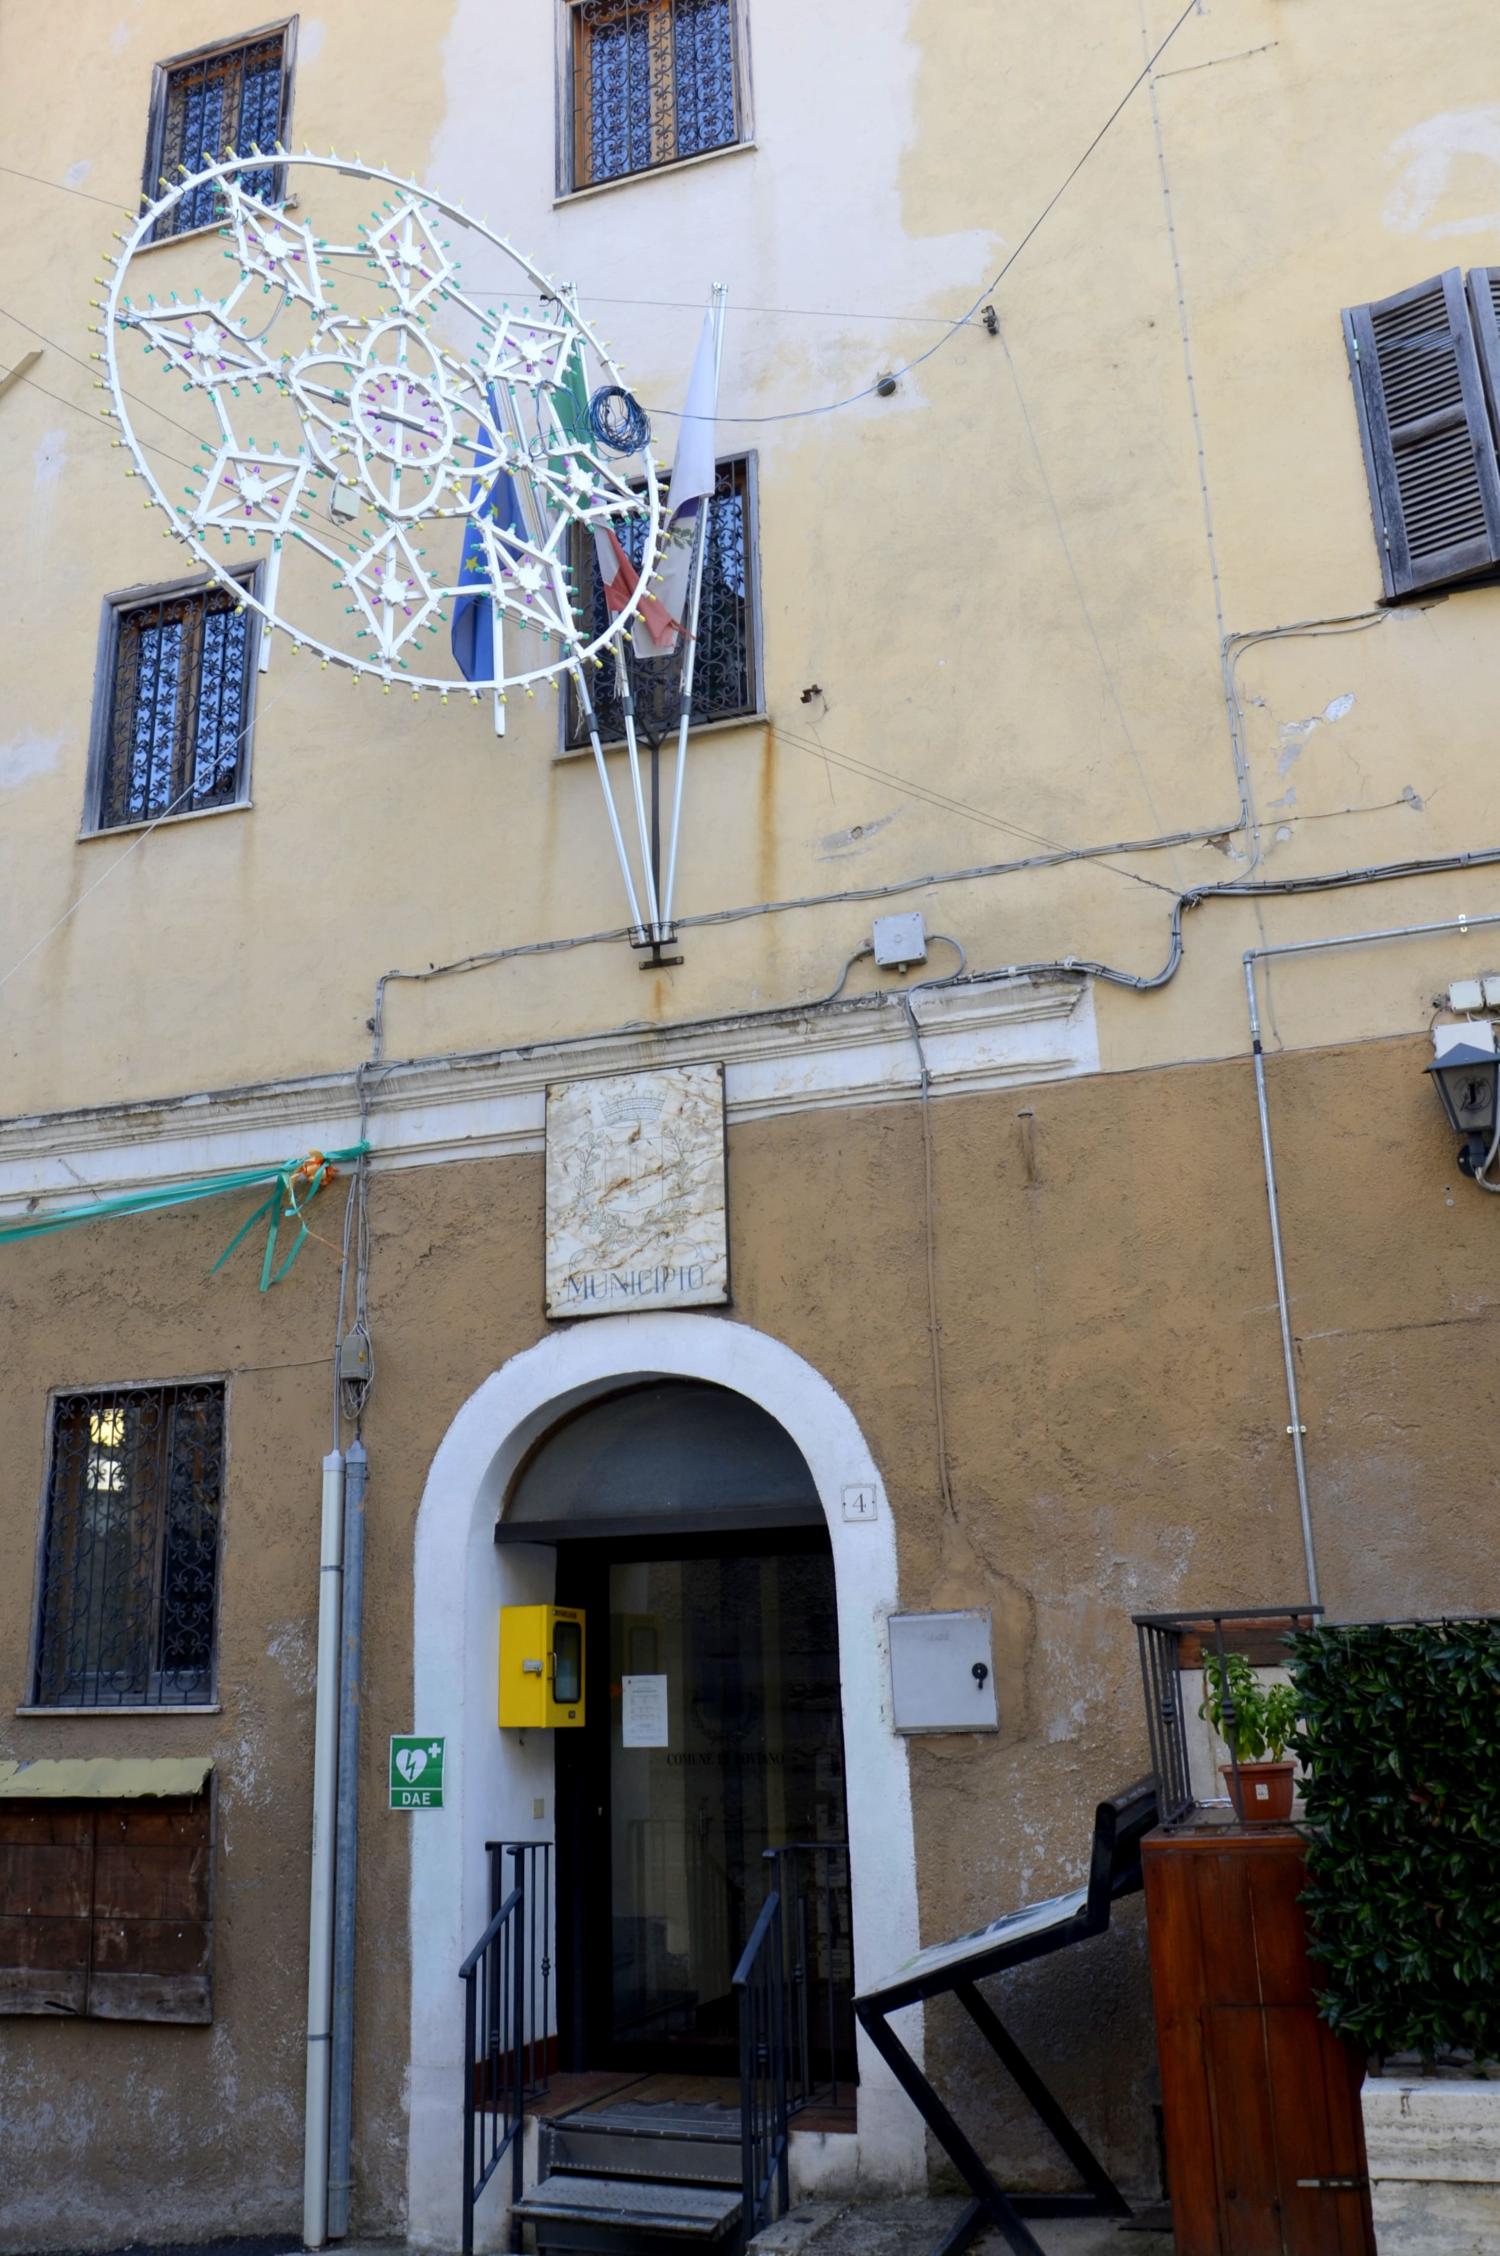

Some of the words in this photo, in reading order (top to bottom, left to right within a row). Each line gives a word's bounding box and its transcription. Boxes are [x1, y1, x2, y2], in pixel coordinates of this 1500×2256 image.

[567, 1264, 704, 1301] MUNICIPIO
[852, 1493, 866, 1512] 4
[666, 1752, 714, 1766] COMUNE
[402, 1792, 431, 1805] DAE
